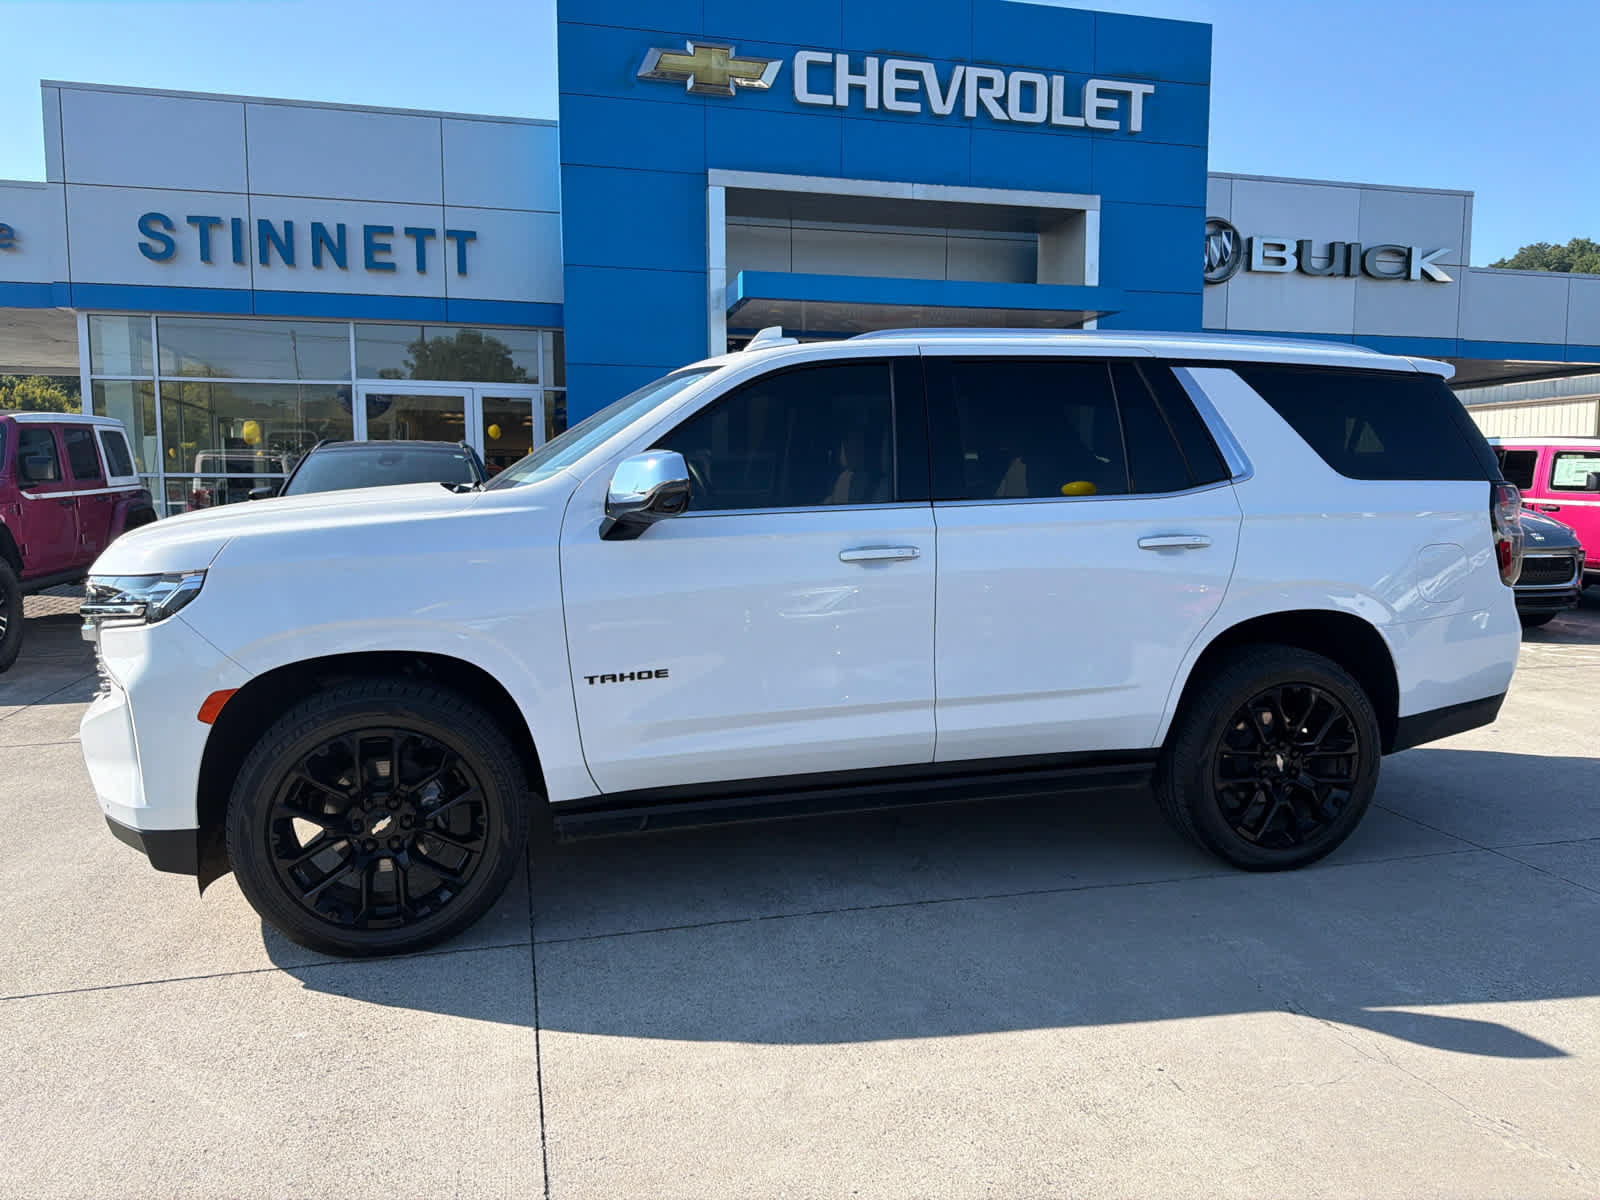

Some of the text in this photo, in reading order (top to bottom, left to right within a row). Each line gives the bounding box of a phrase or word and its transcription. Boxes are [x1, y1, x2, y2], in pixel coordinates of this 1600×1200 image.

[793, 50, 1155, 133] CHEVROLET
[137, 212, 477, 275] STINNETT
[1249, 236, 1453, 283] BUICK
[584, 668, 669, 685] TAHOE
